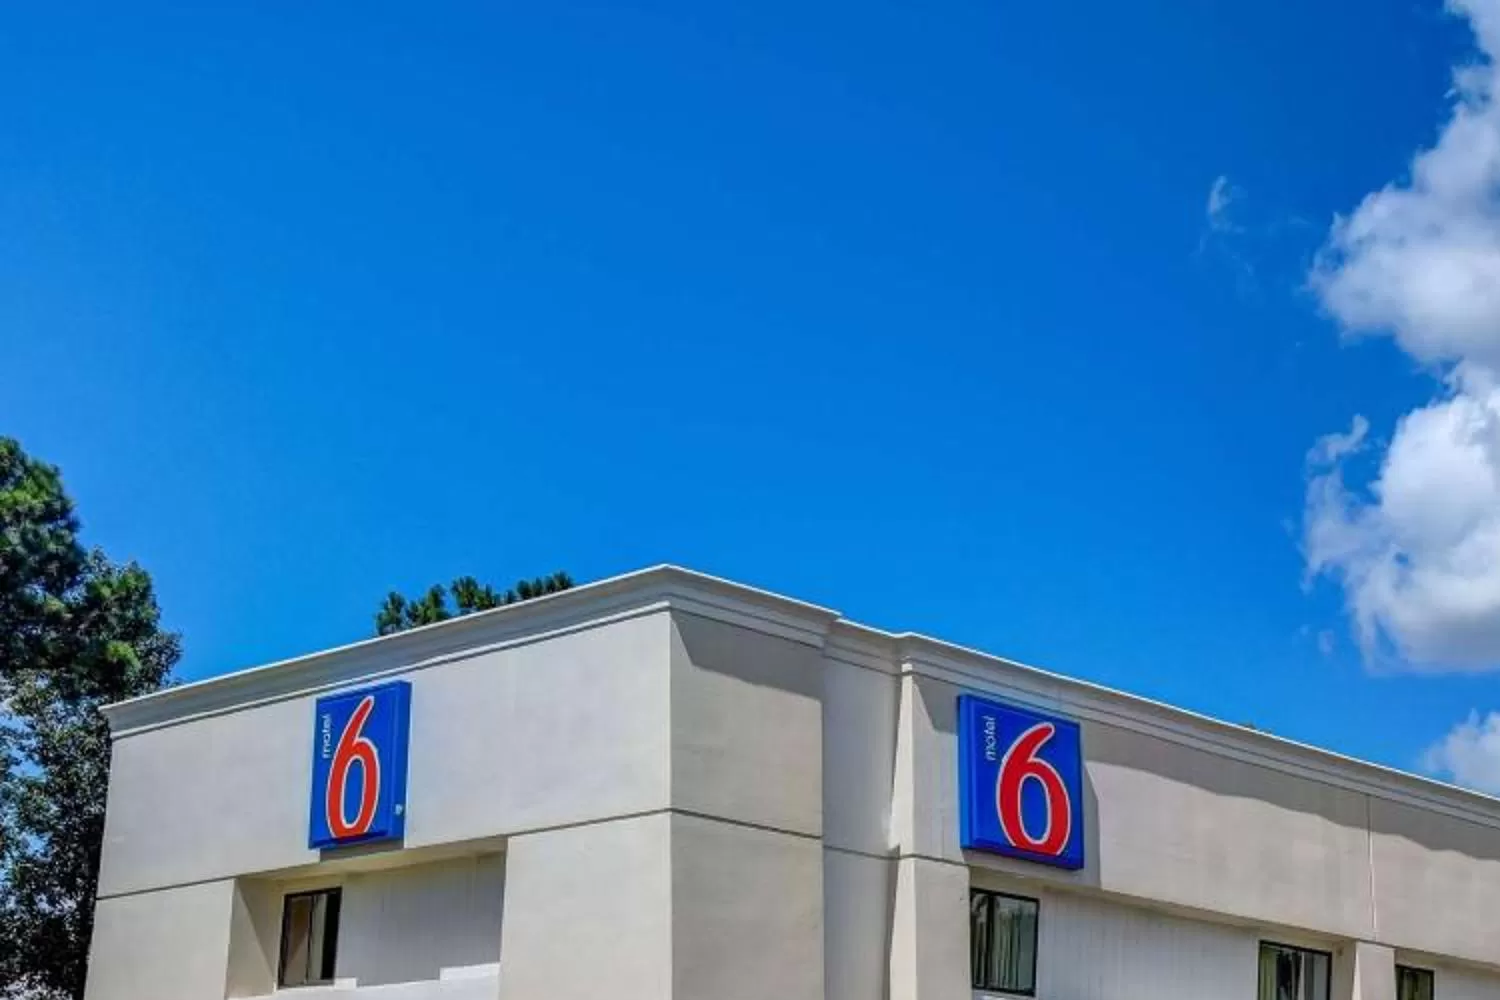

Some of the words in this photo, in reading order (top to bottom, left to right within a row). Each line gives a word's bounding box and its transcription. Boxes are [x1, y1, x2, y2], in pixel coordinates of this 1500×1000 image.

[322, 713, 332, 759] motel
[325, 695, 381, 841] 6
[982, 715, 996, 761] motel
[996, 722, 1071, 857] 6
